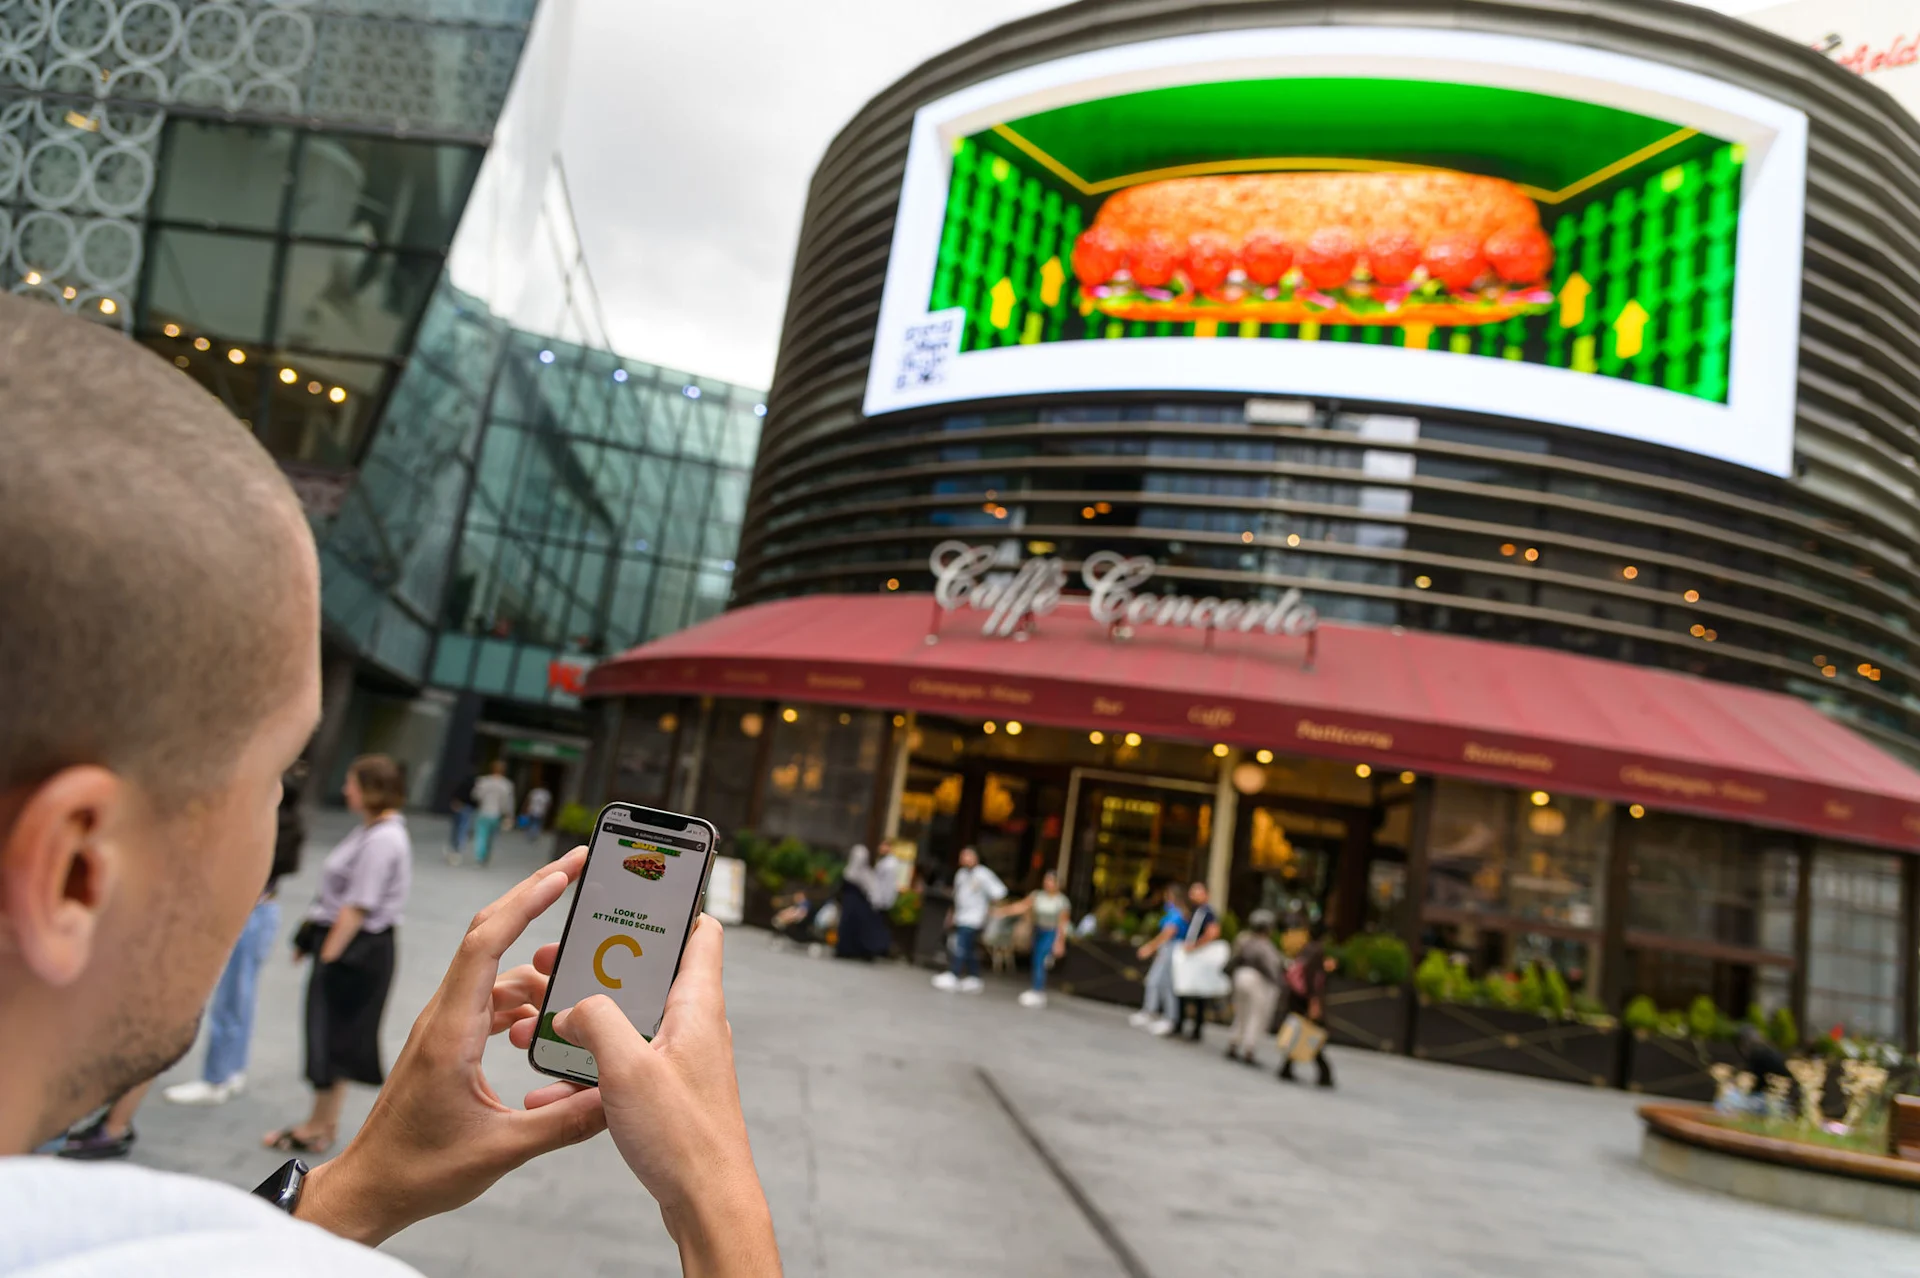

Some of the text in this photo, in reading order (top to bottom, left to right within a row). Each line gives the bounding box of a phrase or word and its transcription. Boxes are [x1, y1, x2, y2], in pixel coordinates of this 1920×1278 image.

[1082, 550, 1320, 636] Concerto
[592, 912, 666, 935] AT THE BIG SCREEN
[613, 907, 648, 921] LOOK UP
